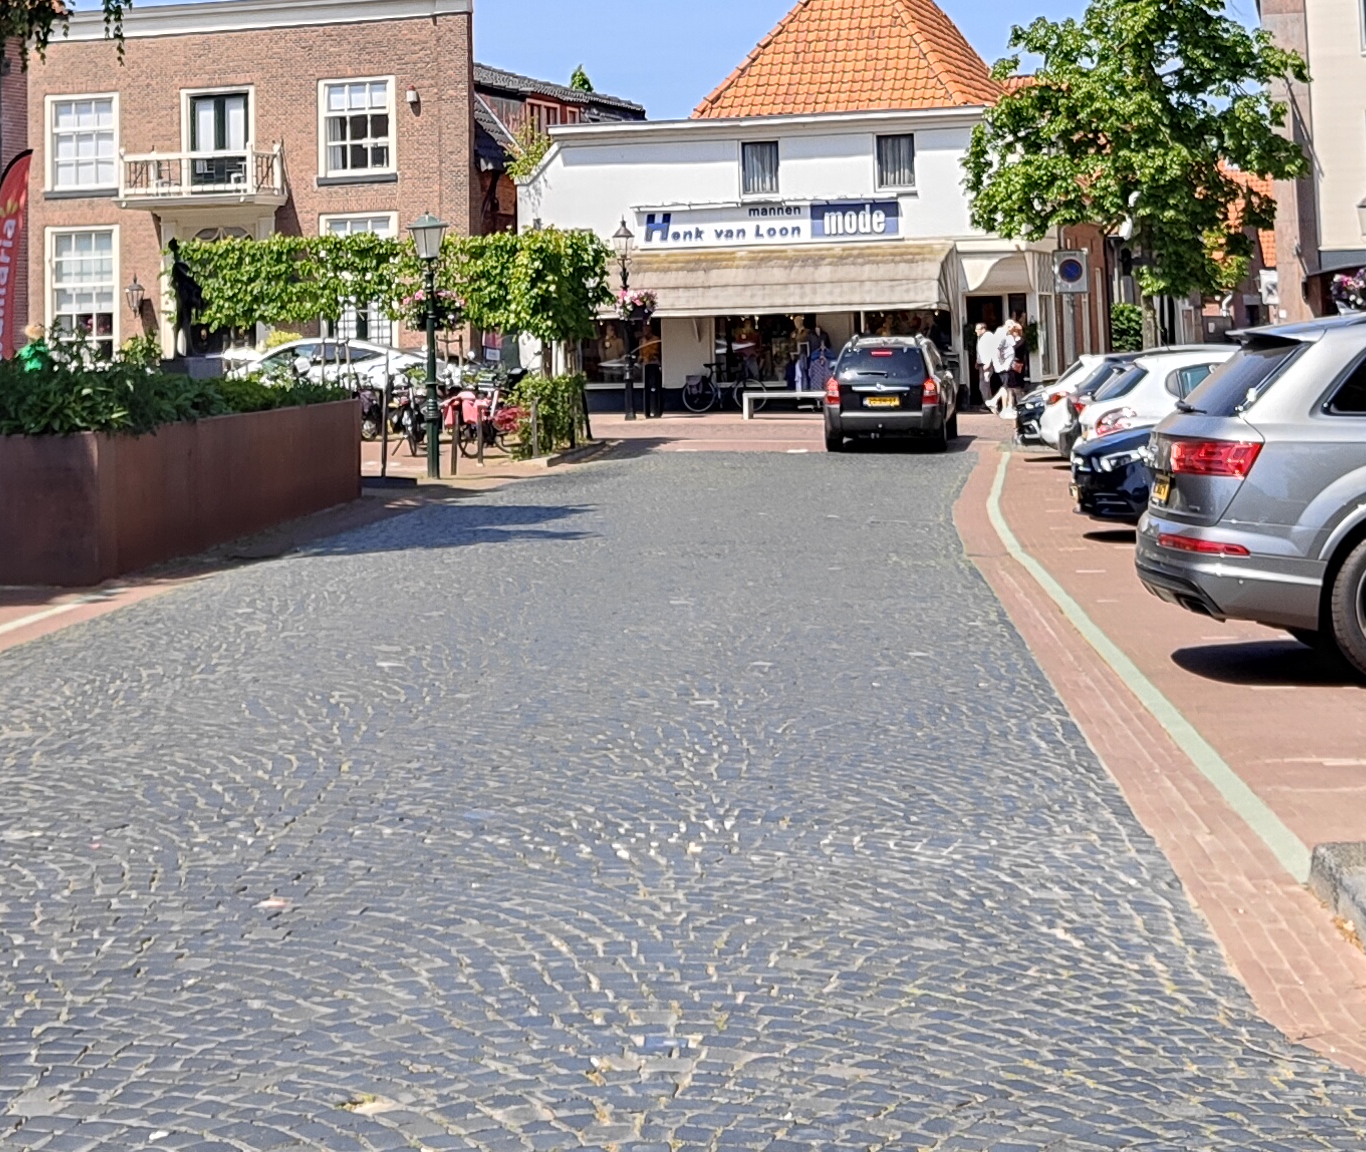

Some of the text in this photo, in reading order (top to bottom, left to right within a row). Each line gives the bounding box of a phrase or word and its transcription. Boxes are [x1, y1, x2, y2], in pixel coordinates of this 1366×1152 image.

[644, 212, 802, 243] Henk van Loon
[748, 206, 801, 218] mannen
[823, 203, 887, 236] mode
